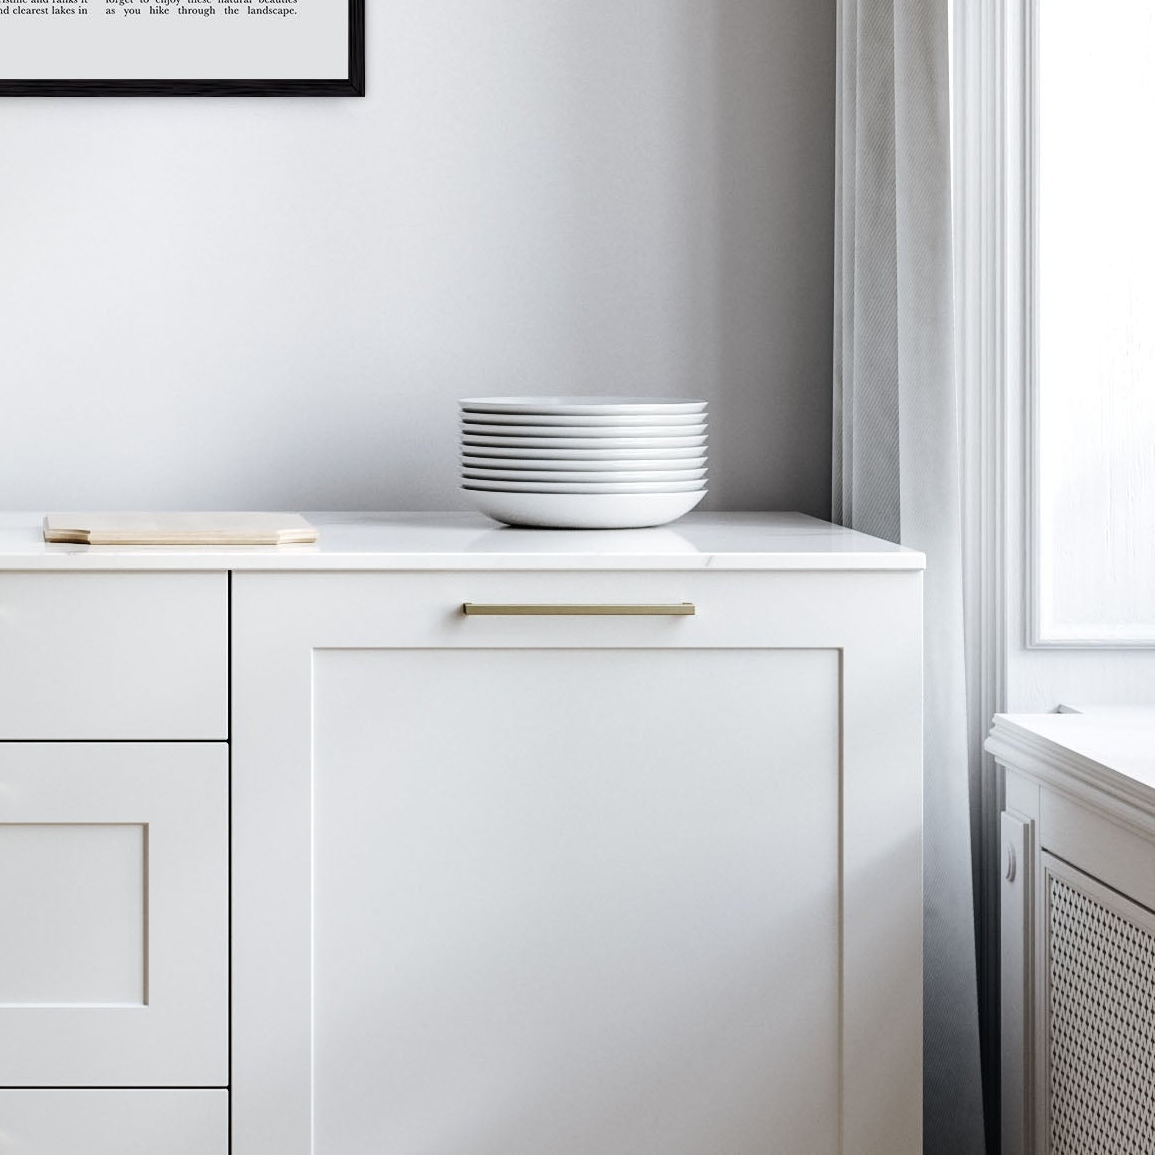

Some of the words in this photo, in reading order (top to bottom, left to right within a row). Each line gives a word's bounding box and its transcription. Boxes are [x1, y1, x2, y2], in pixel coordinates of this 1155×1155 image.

[12, 6, 49, 15] clearest
[52, 6, 76, 15] lakes
[78, 6, 88, 15] in
[123, 8, 141, 18] you
[149, 6, 169, 15] hike
[178, 6, 216, 18] through
[224, 6, 239, 15] the
[247, 6, 297, 18] landscape.
